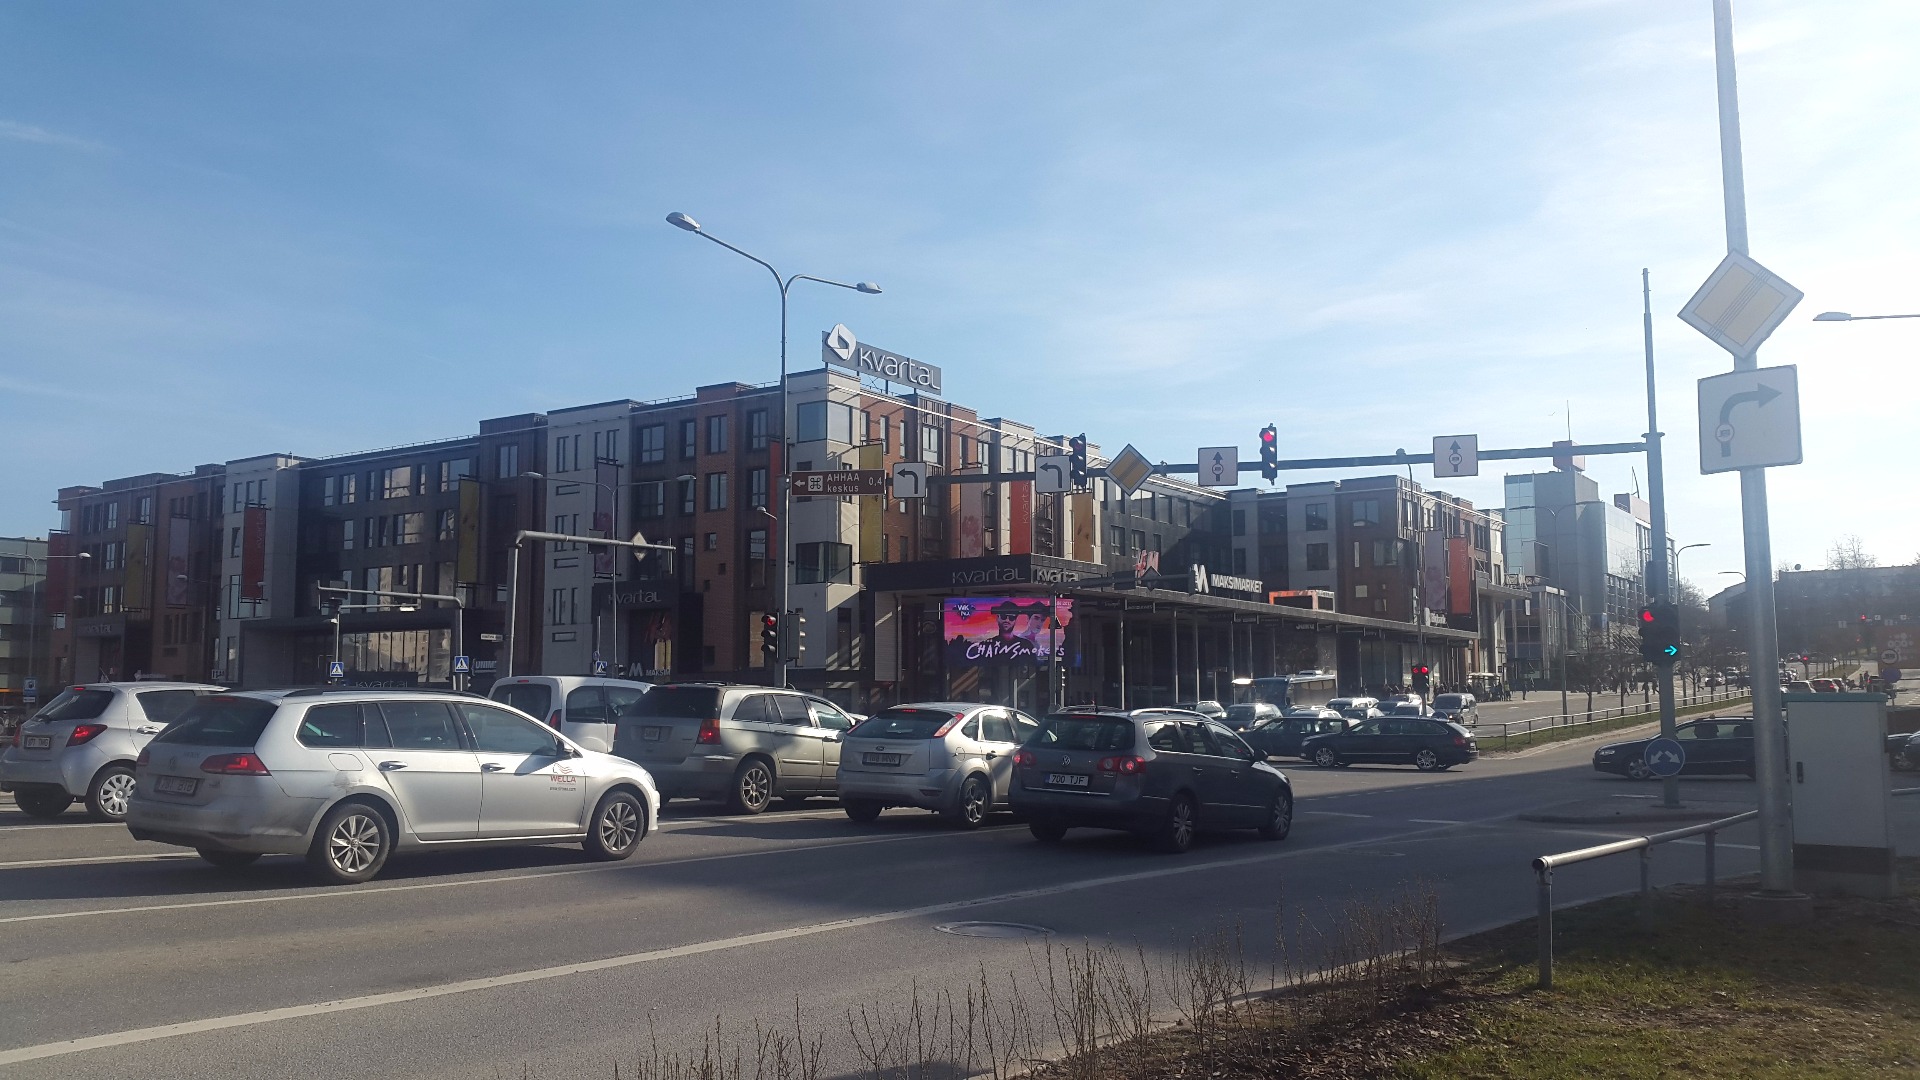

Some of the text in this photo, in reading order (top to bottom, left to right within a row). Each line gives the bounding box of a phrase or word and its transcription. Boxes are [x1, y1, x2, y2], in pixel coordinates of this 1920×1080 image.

[826, 473, 883, 487] AHHAA 0,4
[827, 484, 859, 493] keskus
[1211, 573, 1263, 593] MAKSIMARKET
[1052, 774, 1085, 784] 700 TJF
